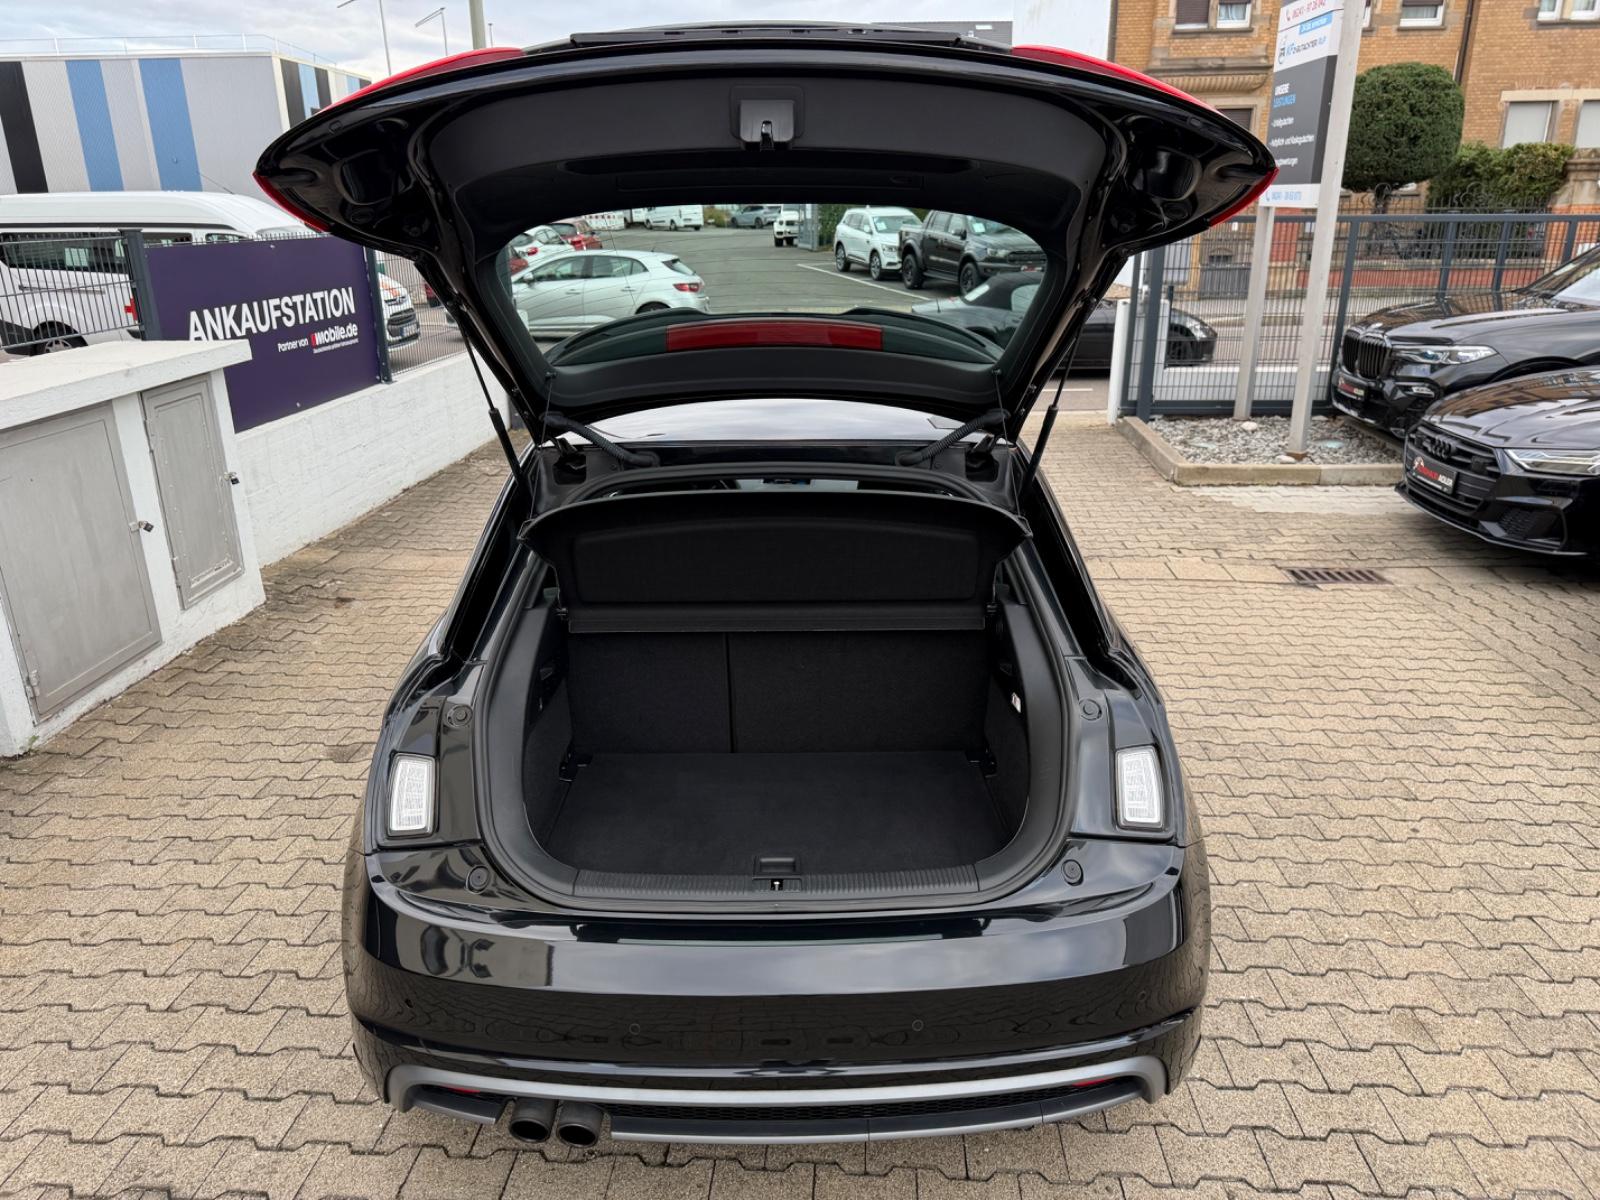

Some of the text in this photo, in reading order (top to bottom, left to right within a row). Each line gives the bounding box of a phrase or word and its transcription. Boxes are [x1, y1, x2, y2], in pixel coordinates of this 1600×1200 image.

[189, 286, 356, 341] ANKAUFSTATION
[277, 341, 298, 353] Partner
[298, 338, 309, 348] von
[311, 322, 358, 348] mobile.de
